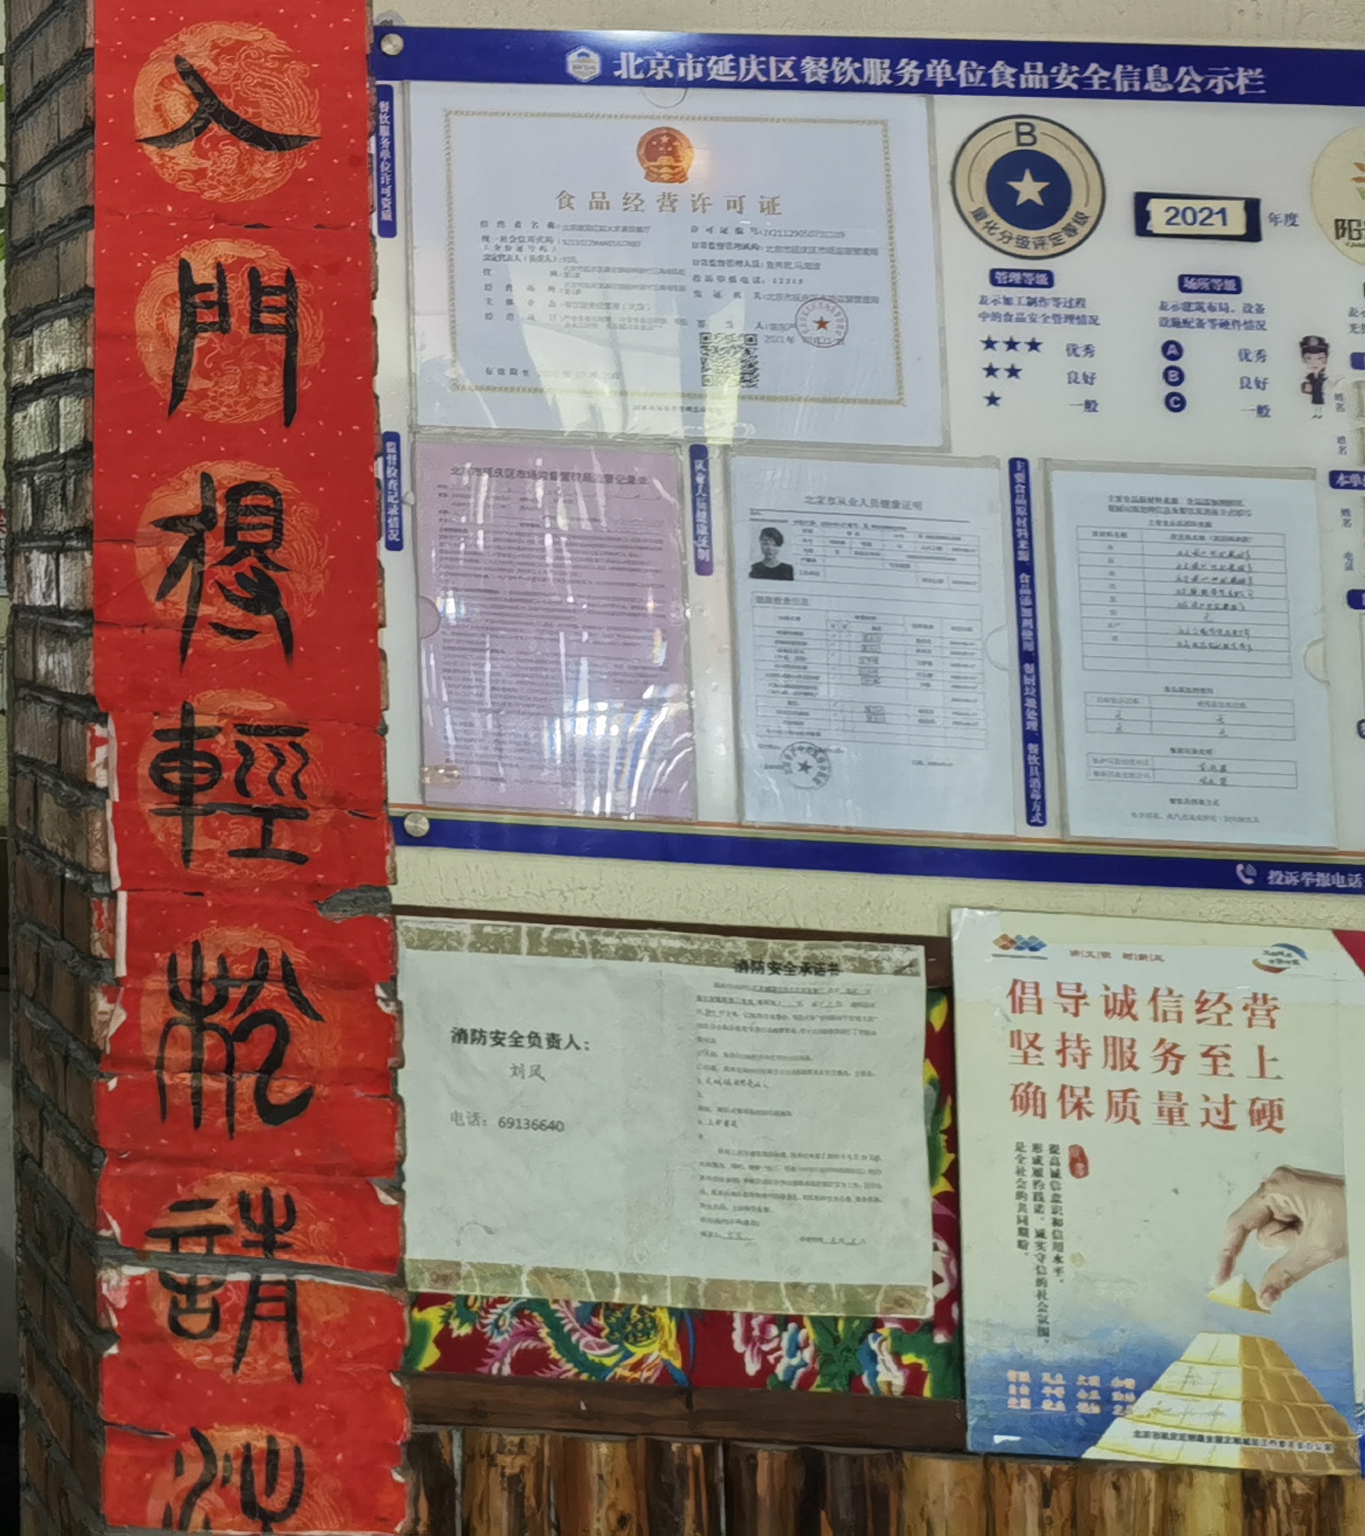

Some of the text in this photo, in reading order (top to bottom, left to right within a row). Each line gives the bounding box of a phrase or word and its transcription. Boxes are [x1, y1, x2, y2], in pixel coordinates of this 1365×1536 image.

[613, 51, 1267, 96] 北京市延庆区餐饮服务单位食品安全信息公示栏
[1015, 121, 1038, 147] B
[555, 190, 782, 215] 食品经营许可证
[970, 206, 1091, 251] 量化分级评定等级
[1165, 206, 1300, 228] 2021 年度
[1065, 343, 1096, 359] 优秀
[1166, 343, 1268, 363] A 优秀
[1066, 370, 1097, 386] 良好
[1167, 369, 1270, 391] B 良好
[1069, 399, 1100, 413] 一般
[1169, 396, 1272, 419] C 一般
[733, 958, 844, 976] 消防安全承诺书
[1007, 978, 1282, 1030] 倡导诚信经营
[450, 1026, 591, 1052] 消防安全负责人：
[1008, 1029, 1284, 1081] 坚持服务至上
[1009, 1080, 1287, 1135] 确保质量过硬
